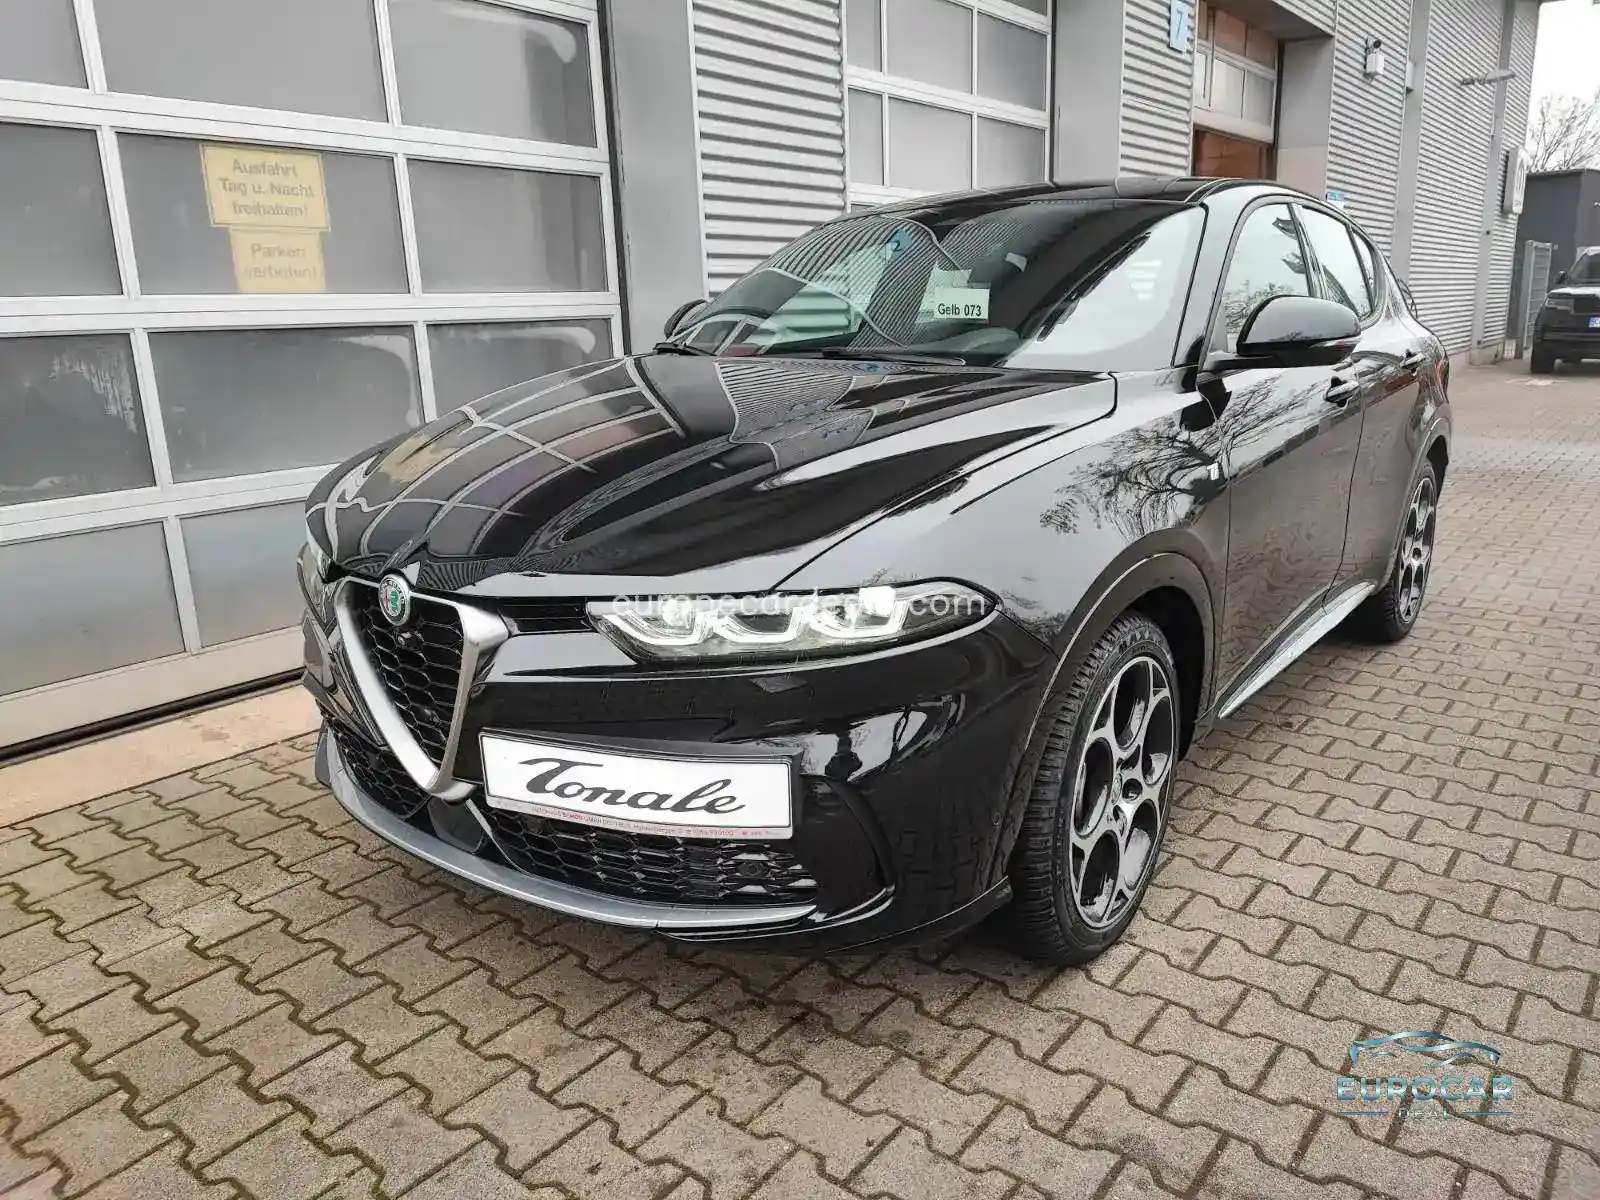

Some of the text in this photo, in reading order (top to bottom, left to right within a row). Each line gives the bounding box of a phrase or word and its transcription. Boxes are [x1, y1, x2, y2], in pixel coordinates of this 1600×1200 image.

[232, 158, 298, 177] Ausfahrt
[218, 177, 316, 198] Tag u. Nacht
[232, 200, 308, 218] freihalten!
[250, 242, 306, 259] Parken
[937, 302, 982, 317] Gelb 073
[518, 757, 746, 815] Tonale
